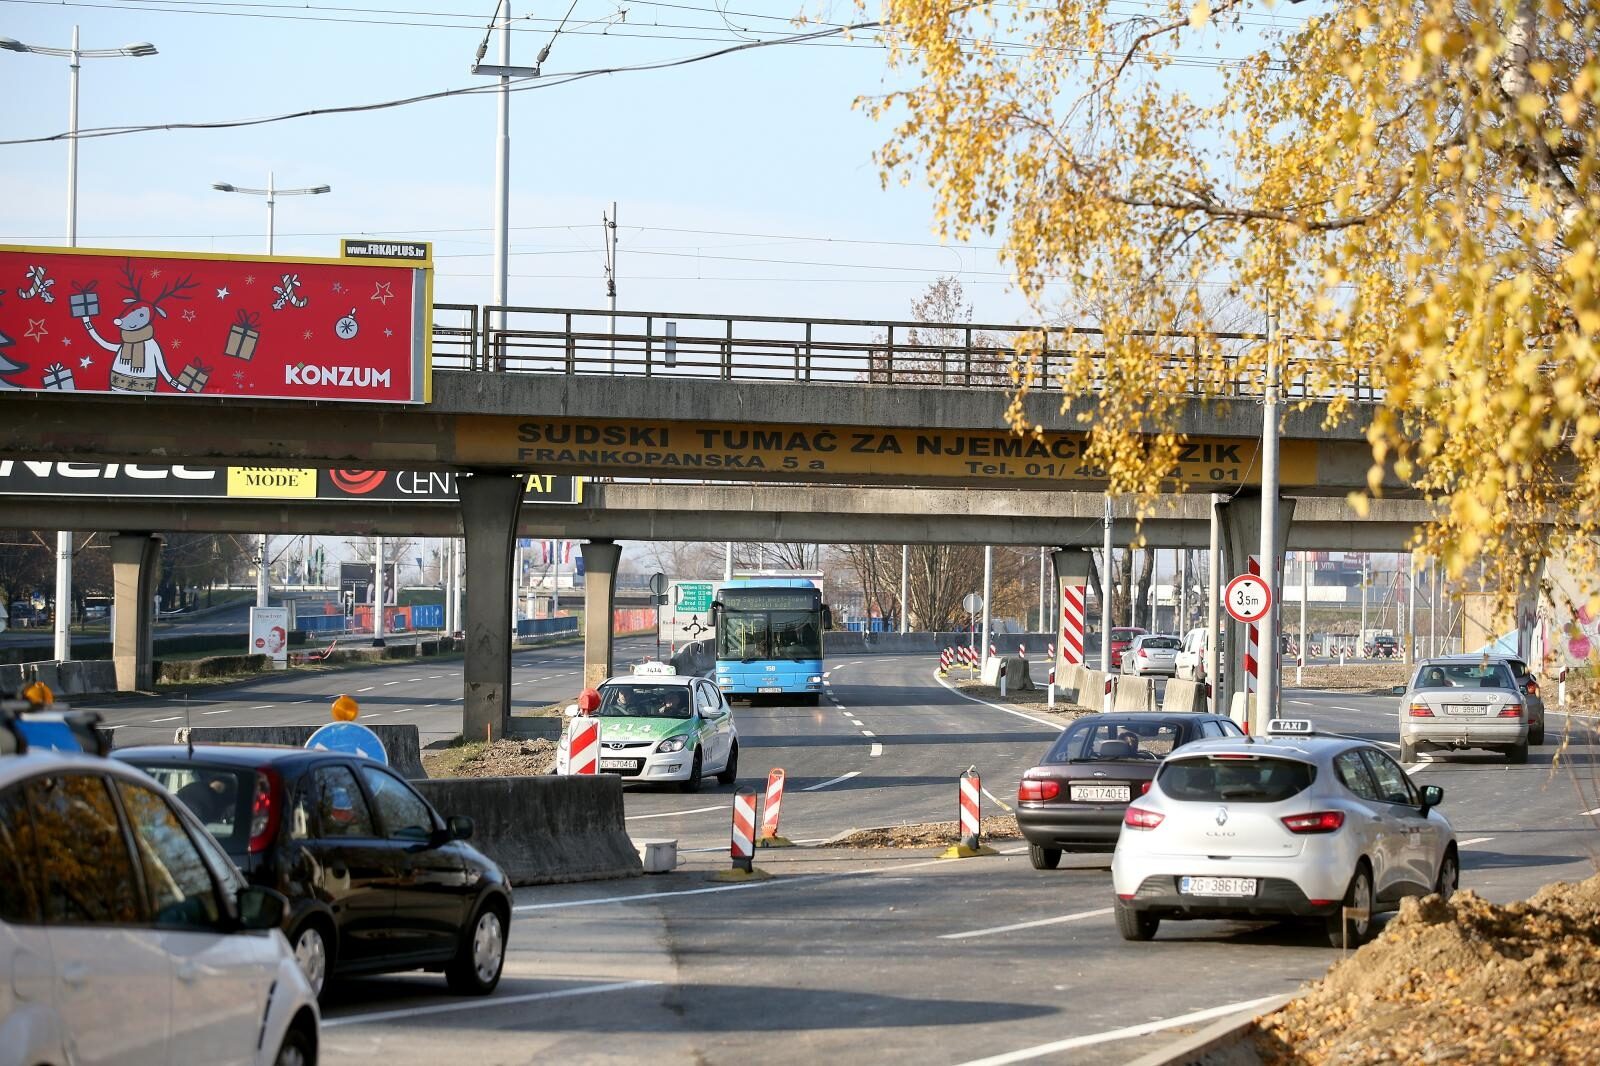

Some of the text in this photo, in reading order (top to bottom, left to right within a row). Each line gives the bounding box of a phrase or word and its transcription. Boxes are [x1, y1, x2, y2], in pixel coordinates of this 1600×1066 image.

[347, 243, 425, 257] www.FRKAPLUS.hr
[285, 363, 391, 388] KONZUM
[517, 422, 669, 448] SUDSKI
[696, 429, 837, 452] TUMAČ
[851, 433, 902, 454] ZA
[517, 447, 765, 468] FRANKOPANSKA
[782, 456, 799, 469] 5
[808, 459, 825, 470] a
[965, 461, 1015, 475] Tel.
[245, 474, 299, 488] MODE
[1280, 722, 1302, 730] TAXI
[1077, 788, 1089, 798] ZG
[1191, 879, 1204, 891] ZG
